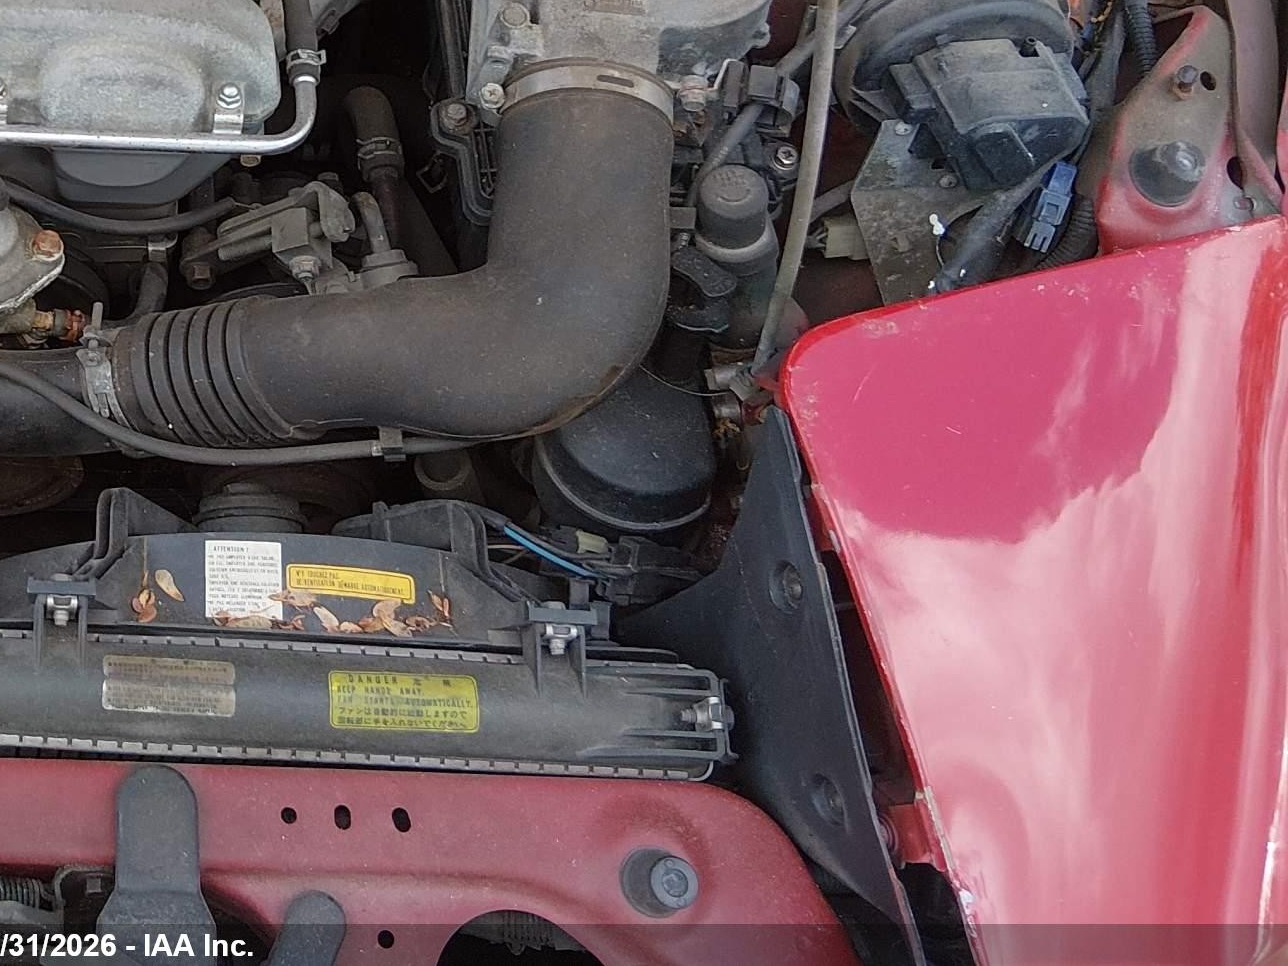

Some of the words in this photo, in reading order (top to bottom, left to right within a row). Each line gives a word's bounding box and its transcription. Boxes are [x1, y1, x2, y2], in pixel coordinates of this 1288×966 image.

[348, 675, 398, 684] DANGER
[337, 686, 356, 694] KEEP
[364, 687, 391, 695] HANDS
[337, 696, 353, 704] FAN
